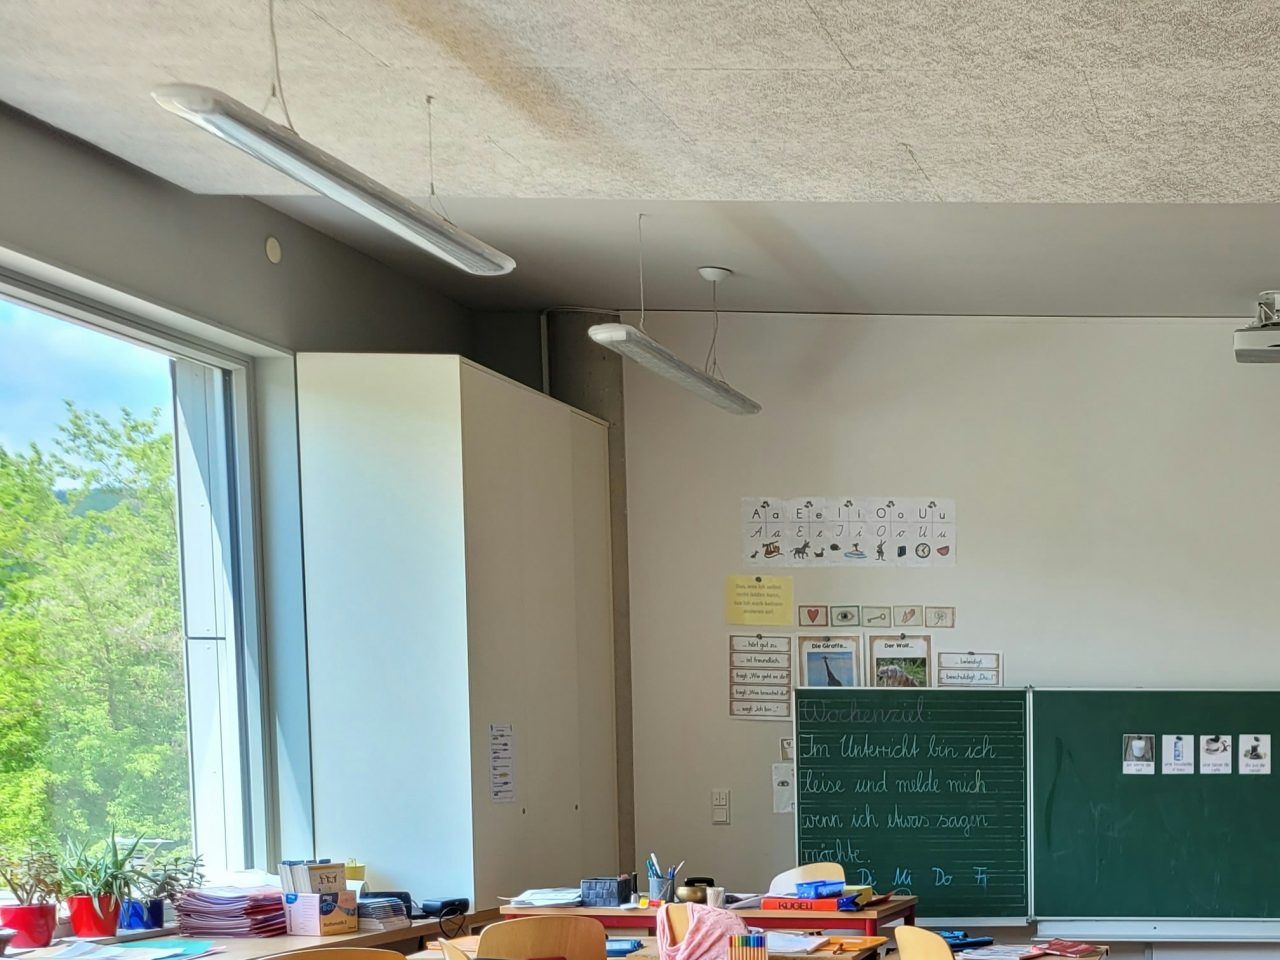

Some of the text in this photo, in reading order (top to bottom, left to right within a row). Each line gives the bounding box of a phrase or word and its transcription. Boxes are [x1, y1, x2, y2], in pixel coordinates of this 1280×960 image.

[802, 733, 997, 759] Im Unterricht bin ich
[803, 768, 845, 793] leise
[854, 769, 888, 793] und
[896, 768, 941, 793] melde
[803, 803, 988, 837] wenn ich etwas sagen
[802, 839, 871, 863] möchte.
[857, 868, 877, 887] Di
[892, 867, 912, 886] Mi
[932, 868, 953, 886] Do
